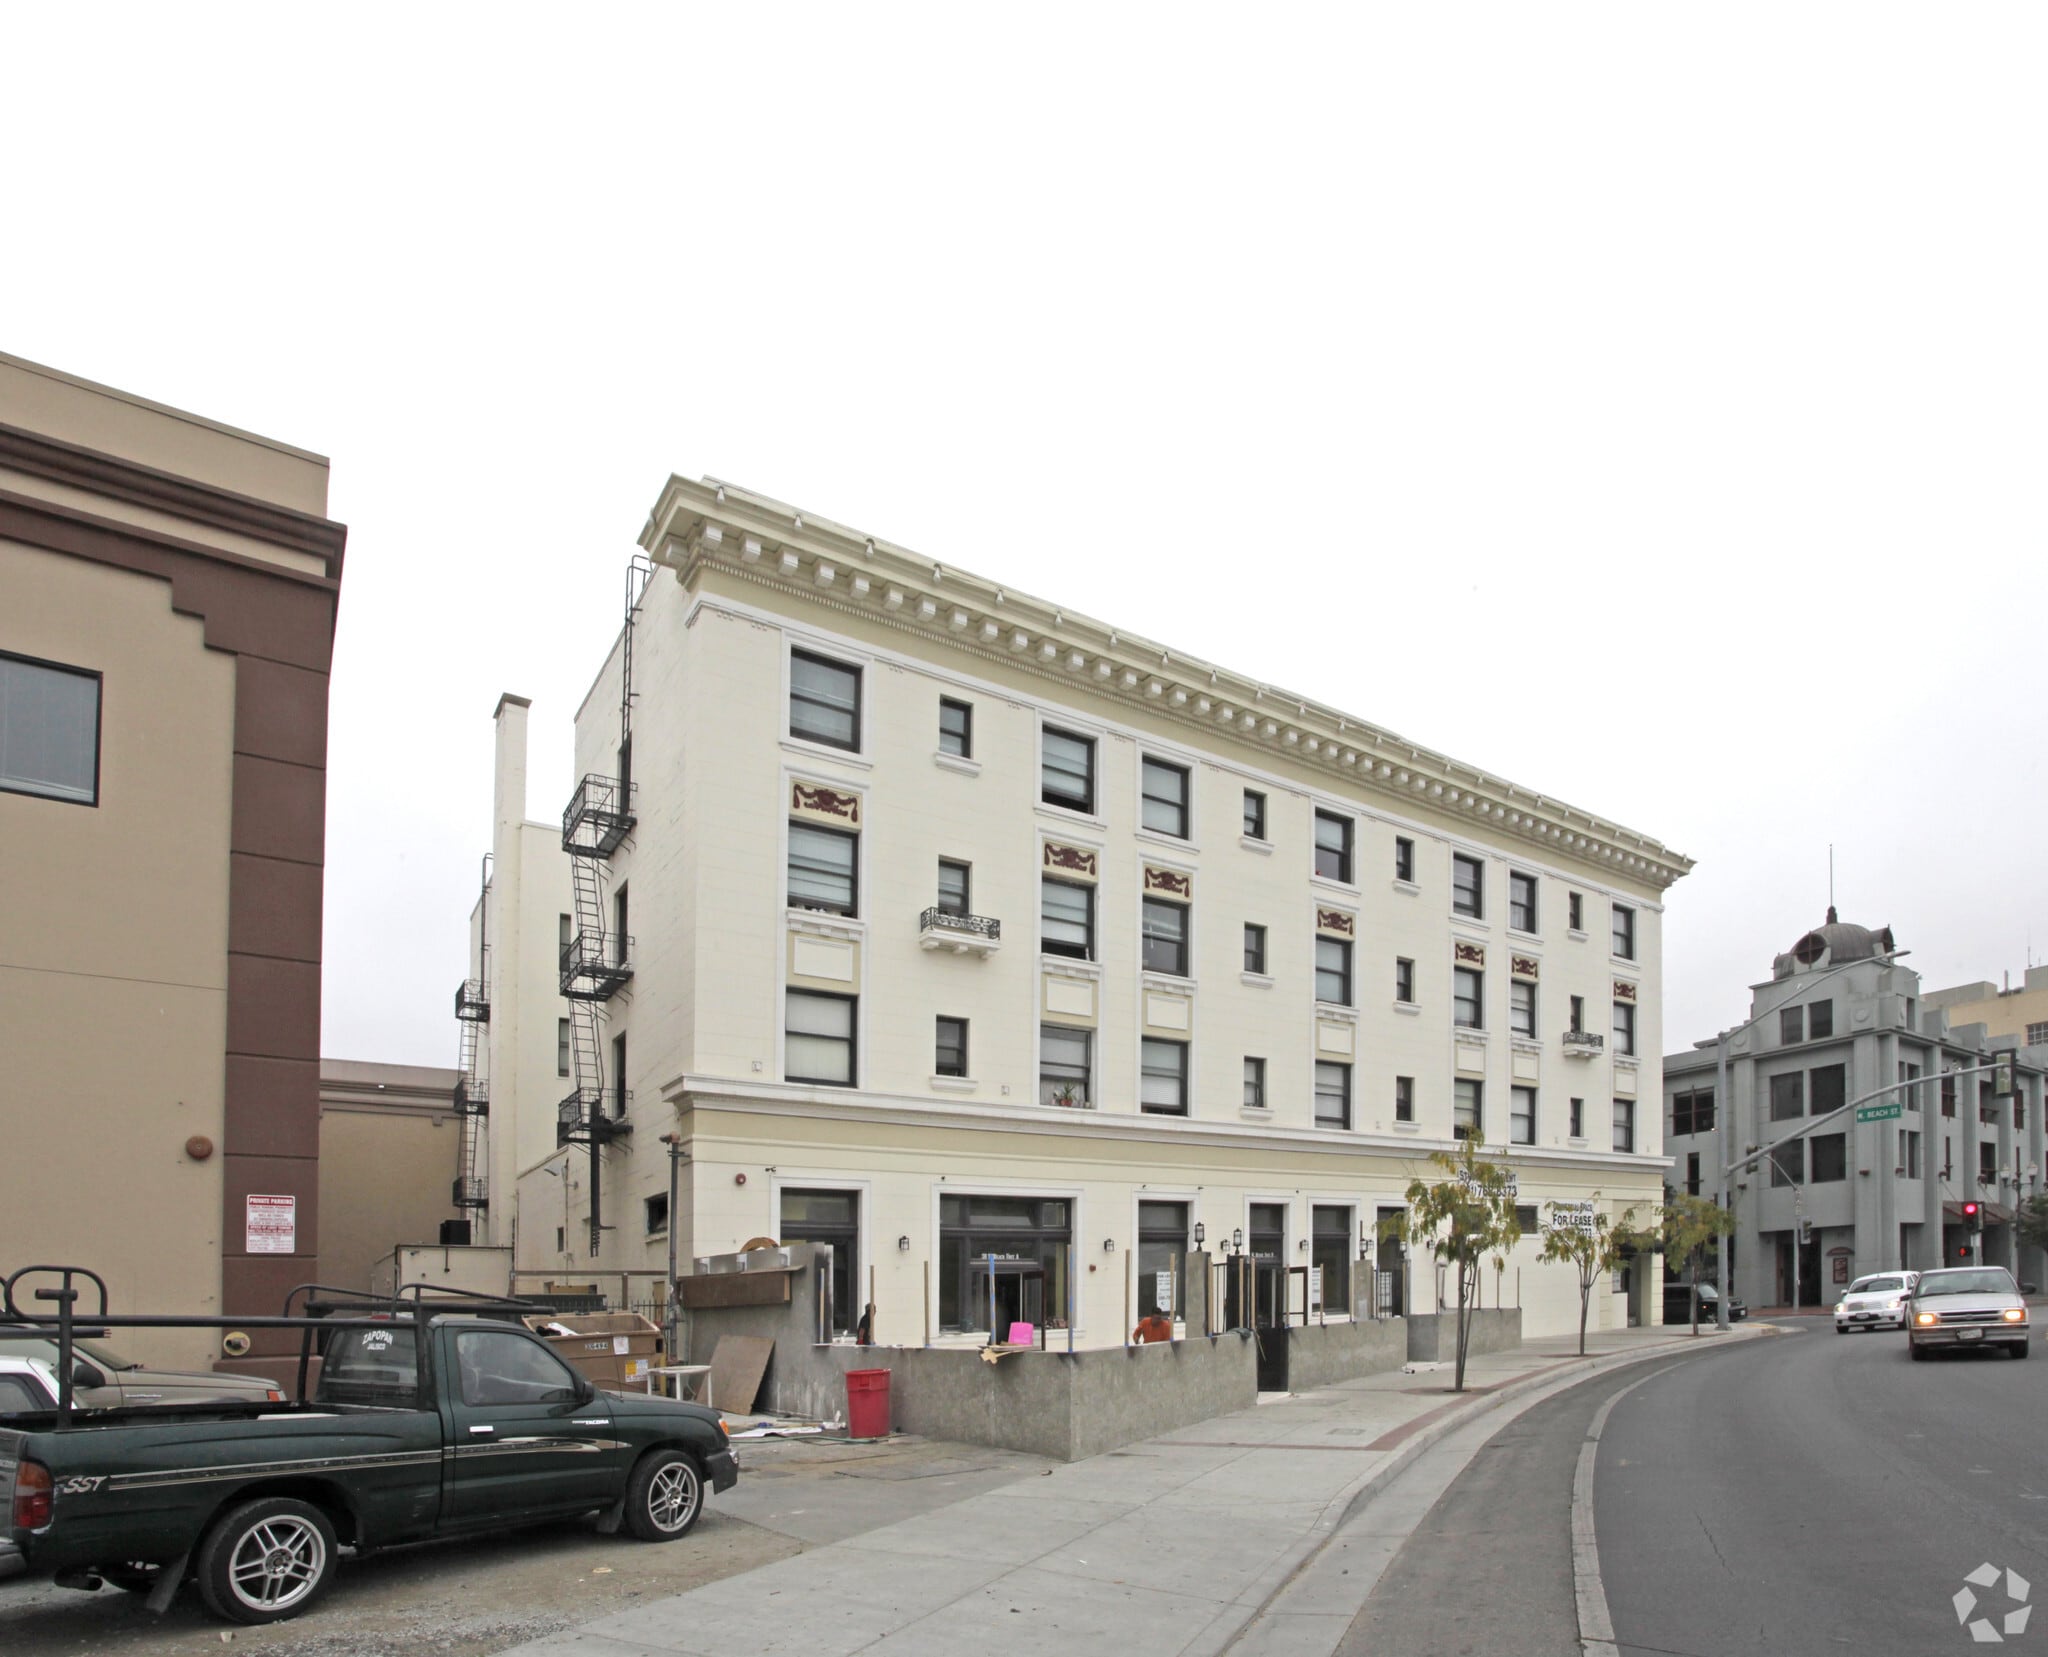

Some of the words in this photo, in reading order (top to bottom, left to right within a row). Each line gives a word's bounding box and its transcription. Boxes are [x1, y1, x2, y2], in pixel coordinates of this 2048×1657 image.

[1867, 1109, 1888, 1118] BEACH
[1553, 1213, 1568, 1226] FOR
[1570, 1214, 1592, 1227] LEASE
[362, 1330, 393, 1345] ZAPOPAN
[63, 1476, 108, 1494] SST
